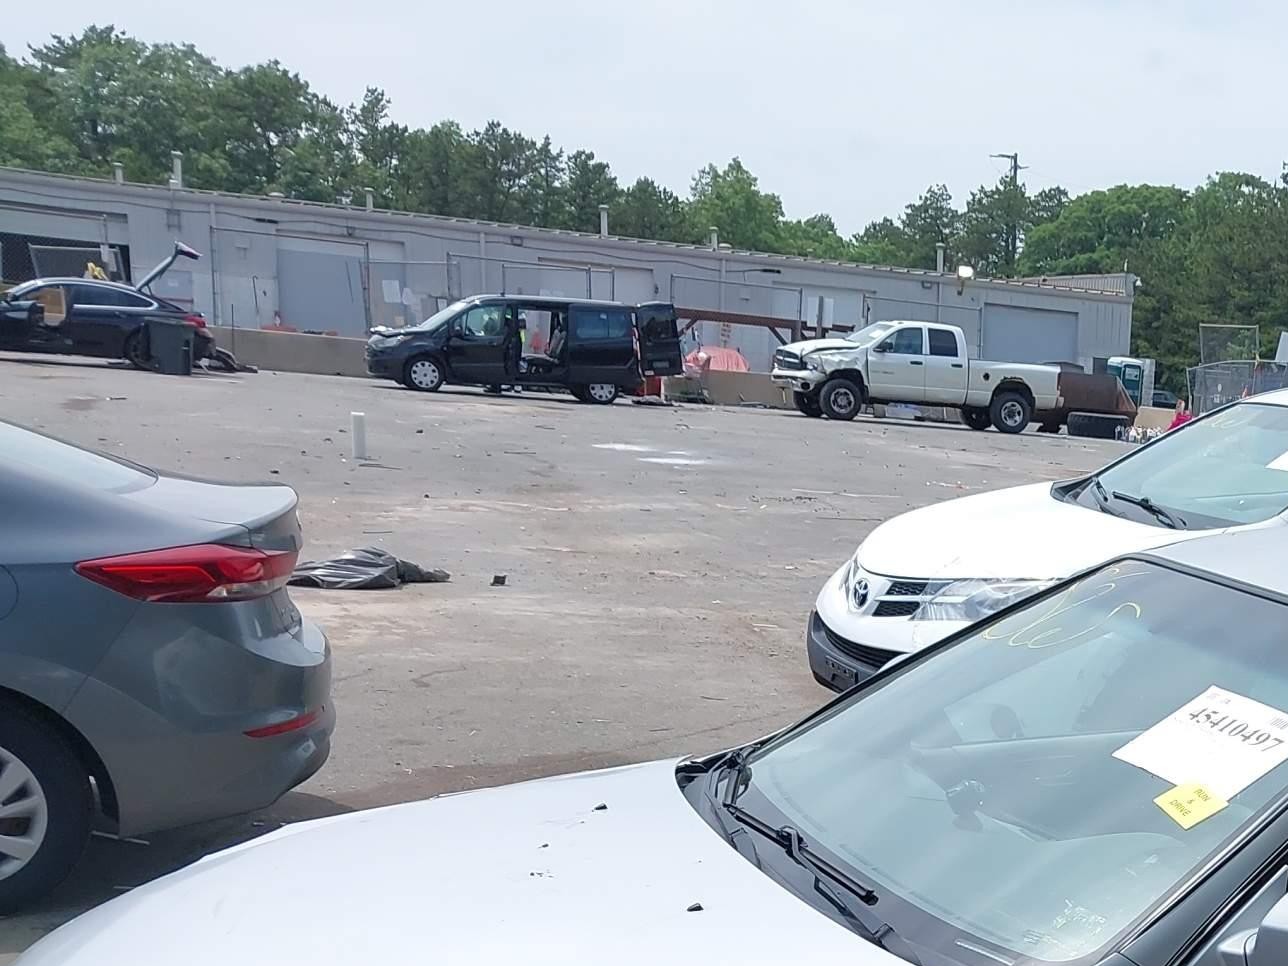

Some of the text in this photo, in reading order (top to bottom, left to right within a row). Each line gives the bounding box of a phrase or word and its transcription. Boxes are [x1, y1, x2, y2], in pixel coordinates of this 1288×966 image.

[1189, 708, 1285, 753] 45410497
[1193, 787, 1211, 802] RUN
[1169, 797, 1191, 818] DRIVE
